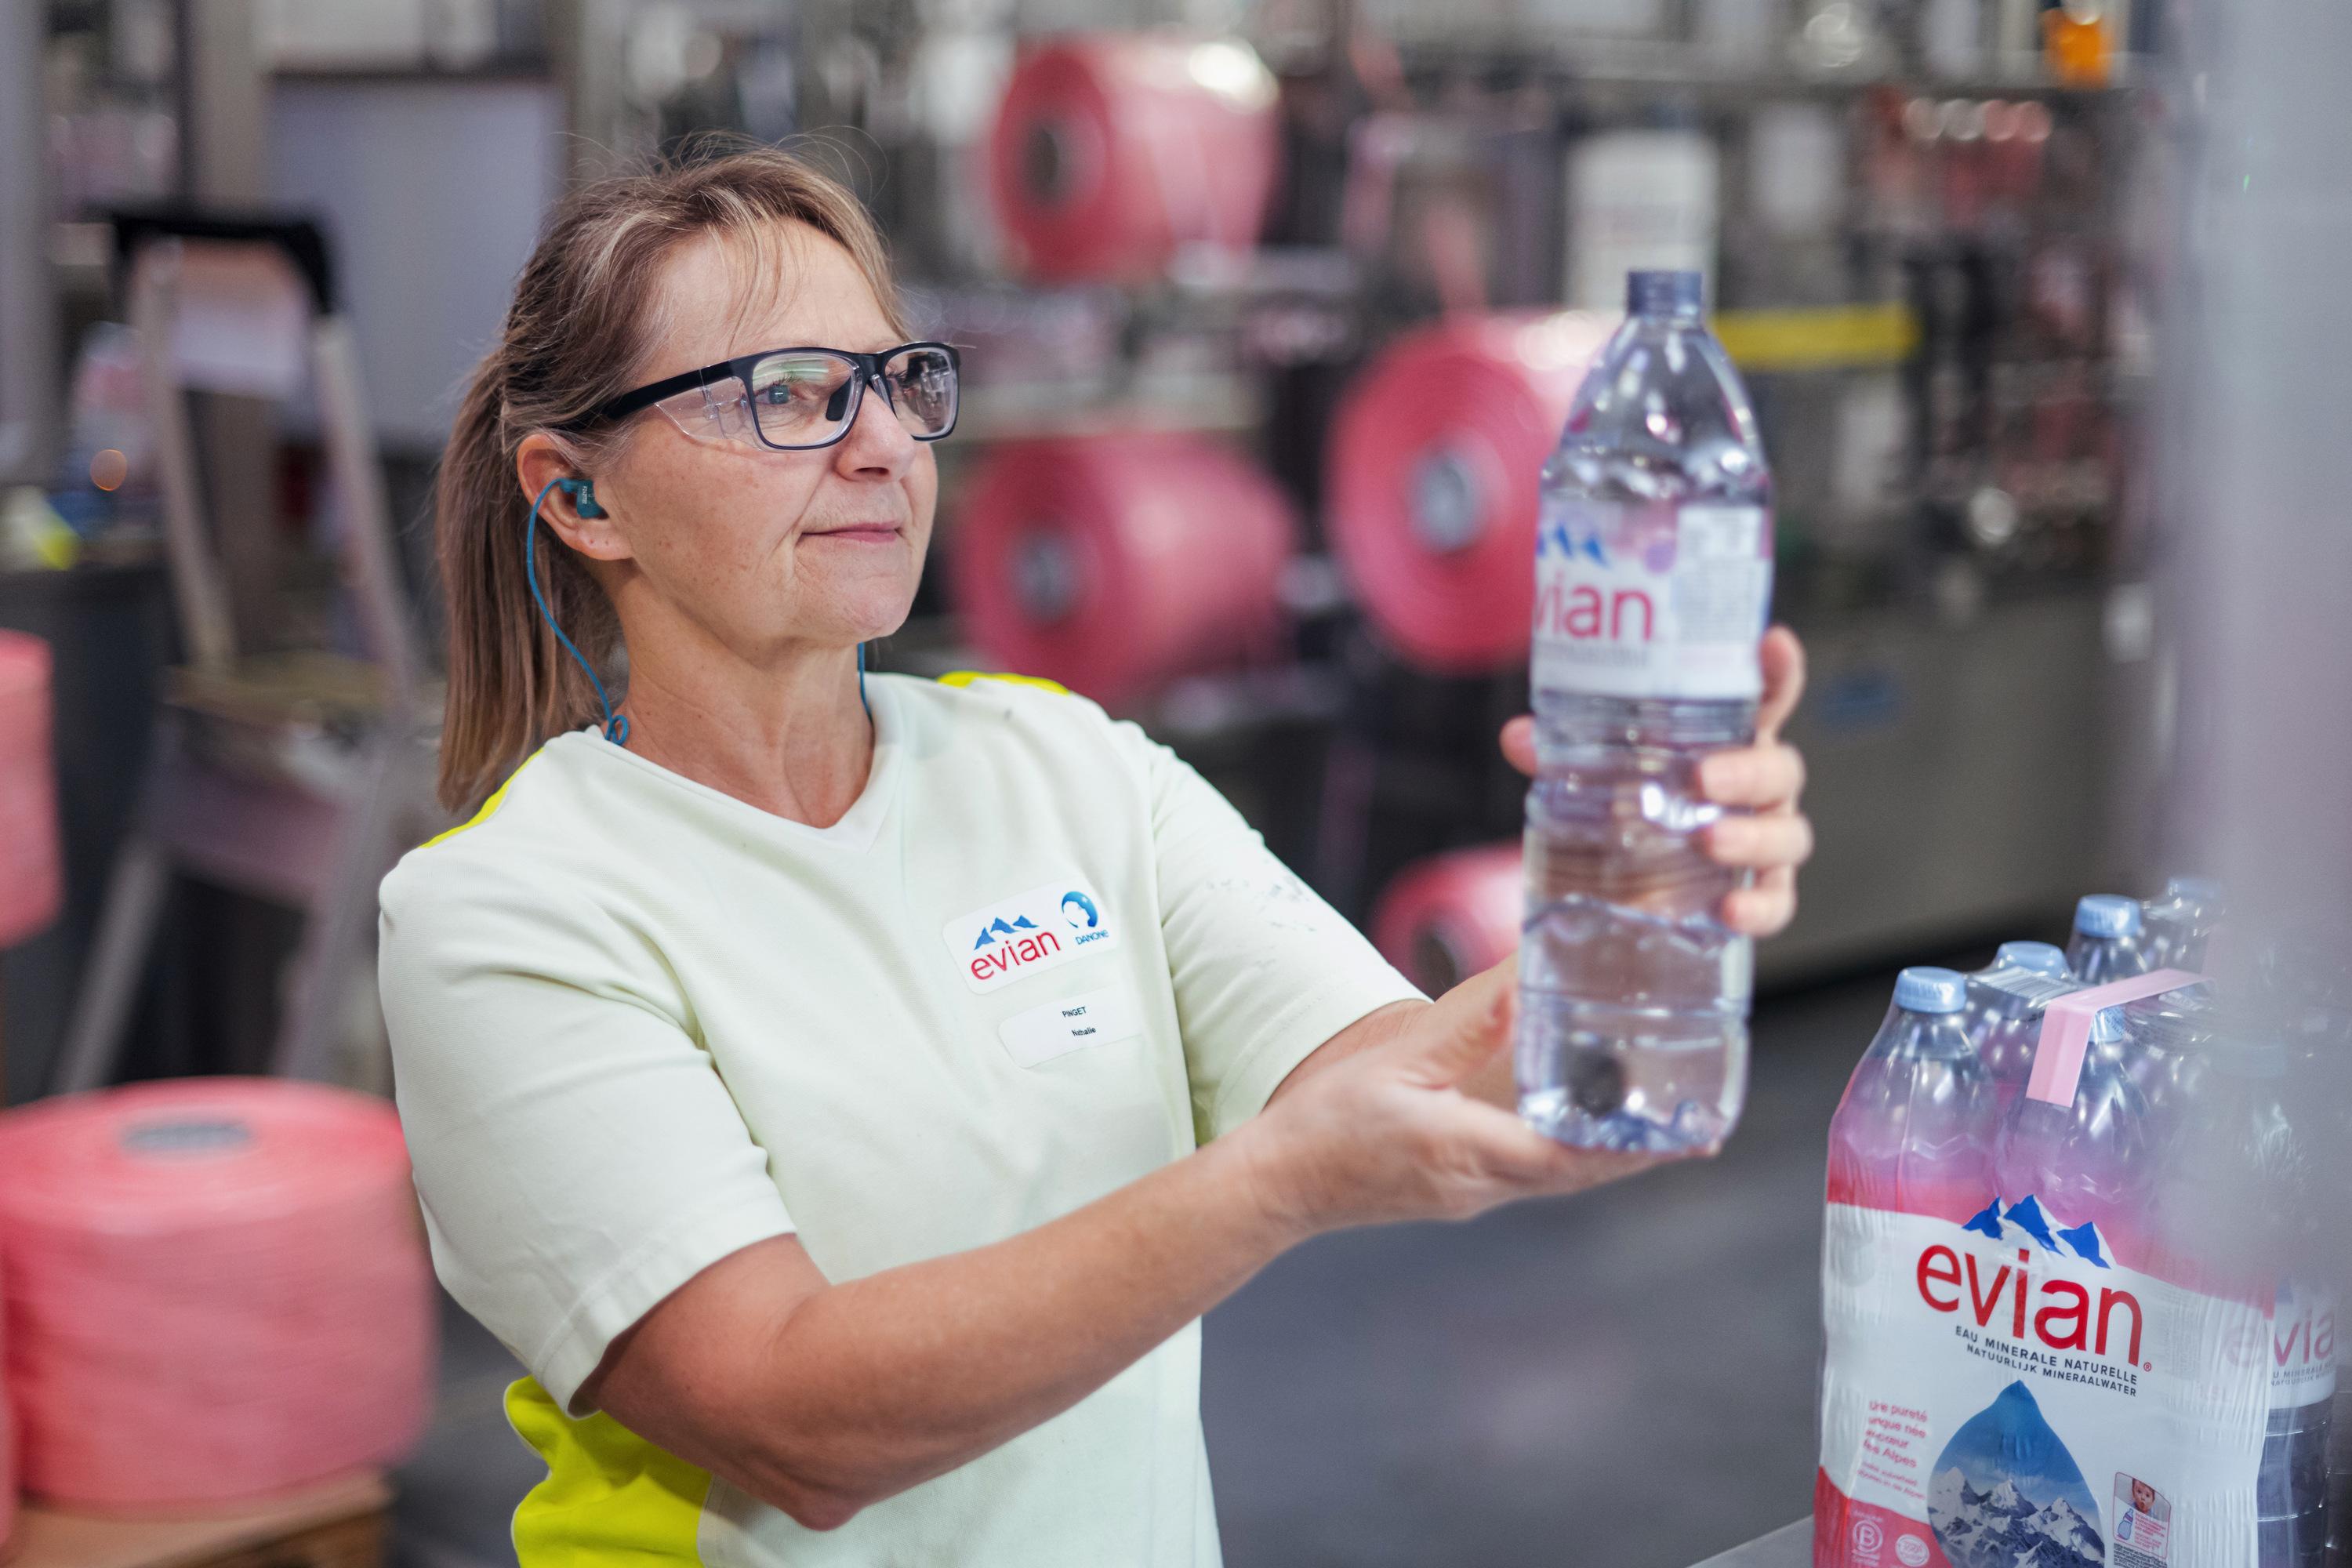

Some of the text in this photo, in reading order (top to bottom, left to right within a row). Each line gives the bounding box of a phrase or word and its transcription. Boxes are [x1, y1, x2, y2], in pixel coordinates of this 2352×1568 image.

[970, 931, 1061, 980] evian
[1075, 930, 1109, 946] DANONE
[1062, 1007, 1087, 1018] PINGET
[1072, 1026, 1096, 1036] Nathalie
[1916, 1244, 2143, 1367] evian
[1955, 1325, 2138, 1385] EAU MINERALE NATURELLE
[1966, 1343, 2136, 1397] NATUURLIJK MINERAALWATER
